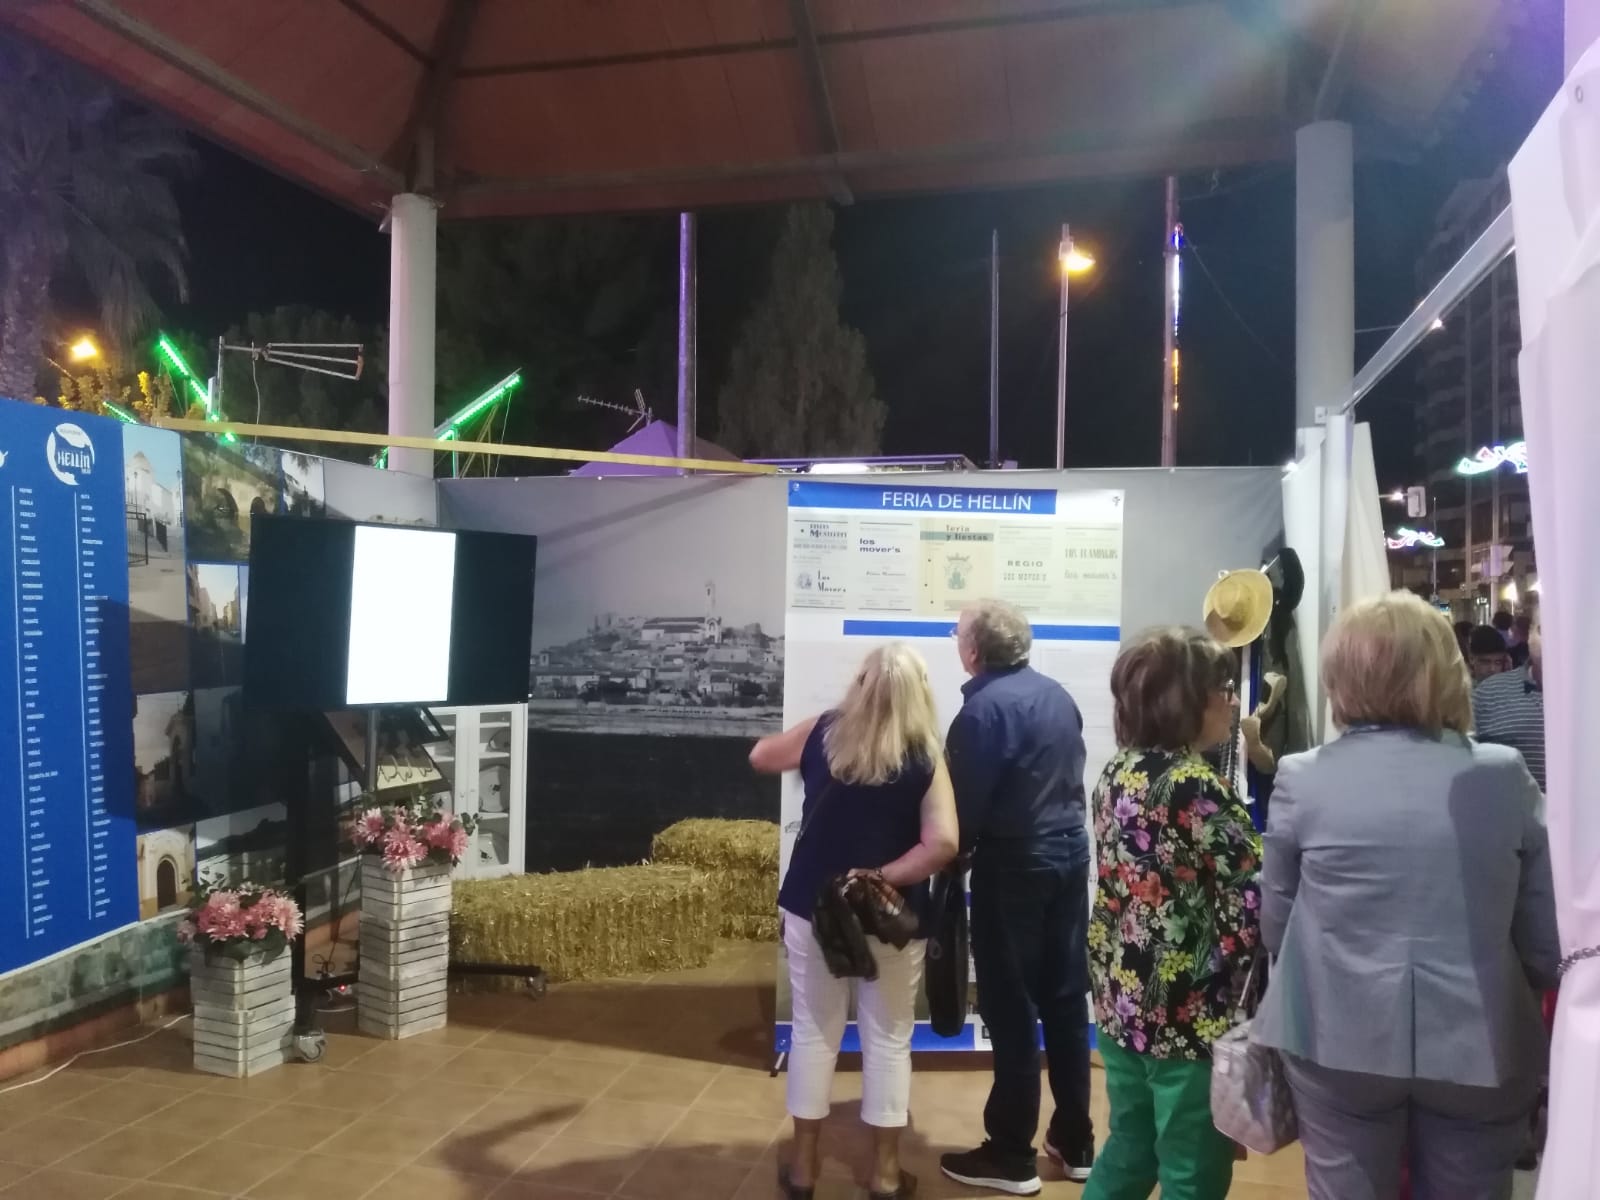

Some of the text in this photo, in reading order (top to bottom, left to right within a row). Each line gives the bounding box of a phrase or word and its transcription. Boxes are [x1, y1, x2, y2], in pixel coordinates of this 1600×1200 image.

[882, 491, 1032, 511] FERIA DE HELLÍN
[1007, 560, 1044, 568] REGIO
